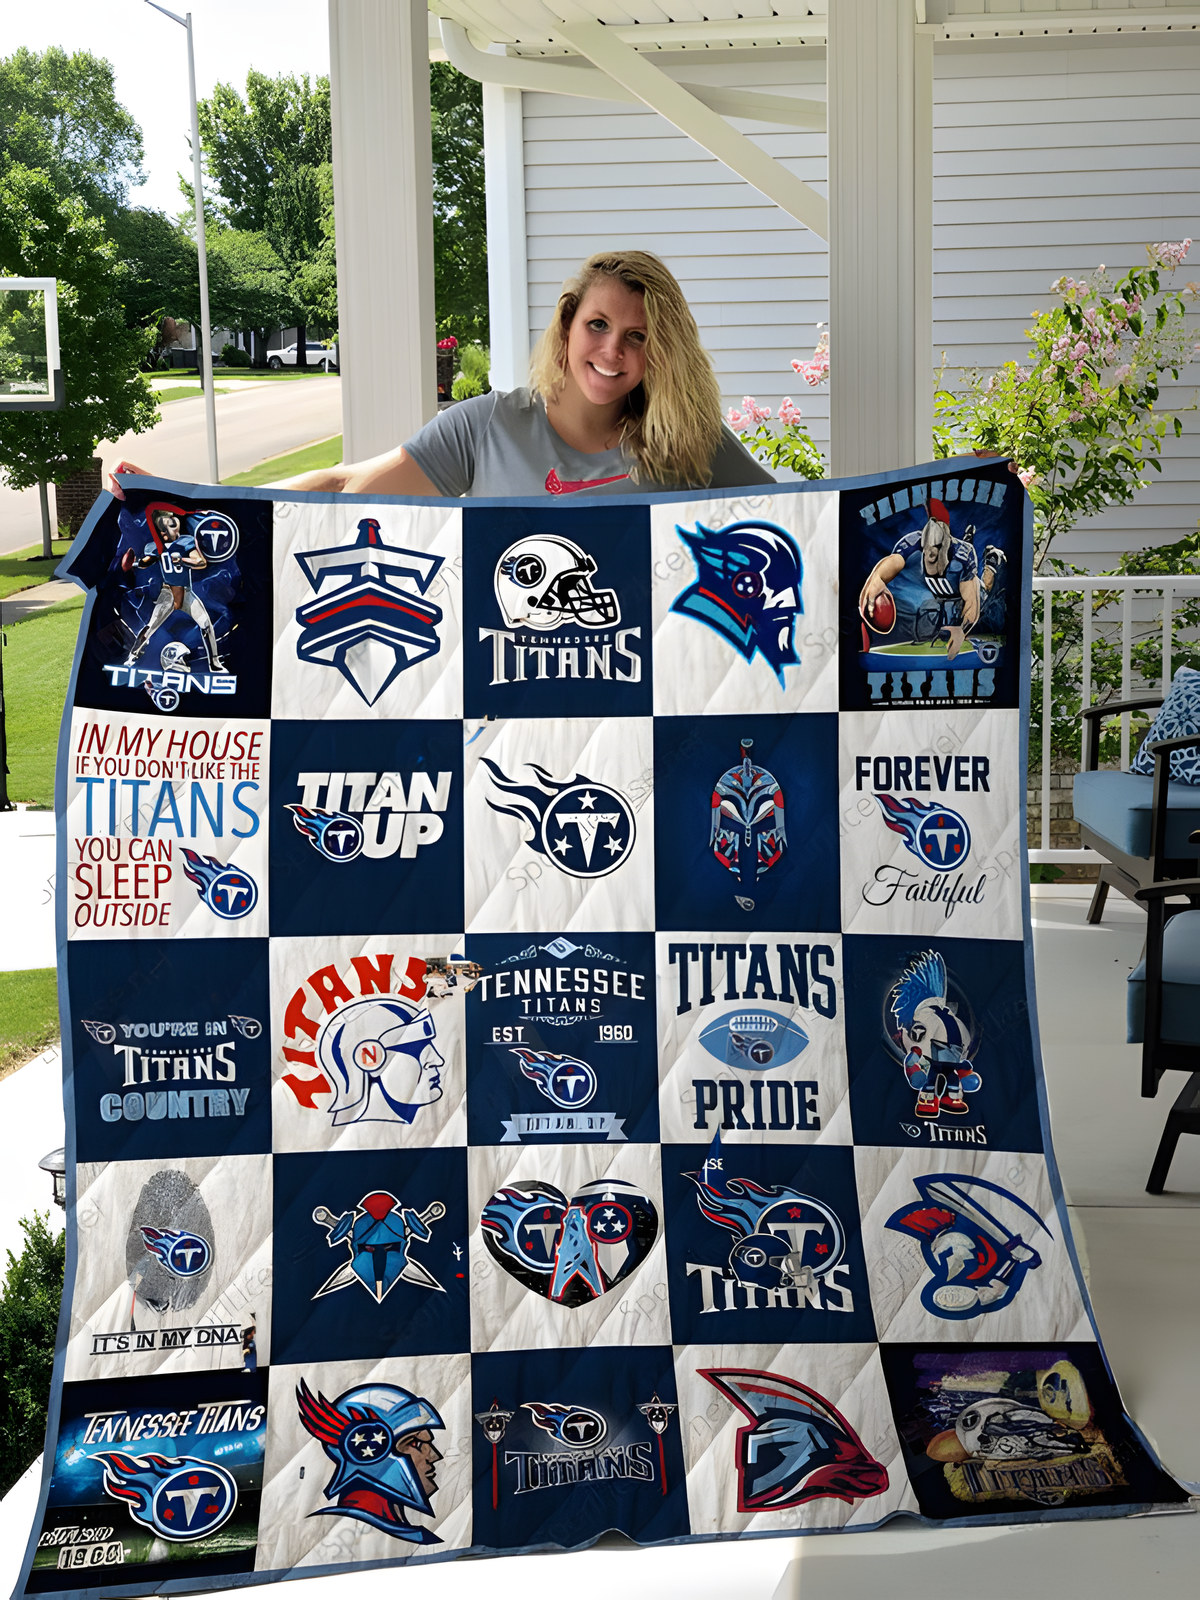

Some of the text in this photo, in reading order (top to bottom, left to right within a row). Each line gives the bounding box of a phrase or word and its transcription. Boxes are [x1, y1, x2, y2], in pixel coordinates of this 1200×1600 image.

[478, 626, 642, 686] TITANS
[102, 665, 238, 695] TITANS
[77, 722, 264, 761] IN MY HOUSE
[76, 755, 260, 780] IF YOU DON'T LIKE THE
[855, 755, 991, 792] FOREVER
[75, 777, 260, 838] TITANS
[297, 771, 452, 813] TITAN
[75, 837, 172, 862] YOU CAN
[363, 811, 444, 859] UP
[75, 863, 172, 900] SLEEP
[862, 864, 987, 919] Faithful
[75, 902, 171, 928] OUTSIDE
[478, 967, 646, 1001] TENNESSEE
[668, 943, 837, 1019] TITANS
[521, 997, 601, 1014] TITANS
[280, 953, 428, 1110] TITANS
[492, 1026, 525, 1042] EST
[599, 1025, 633, 1041] 1960
[114, 1041, 236, 1087] TITANS
[100, 1088, 251, 1122] COUNTRY
[692, 1079, 821, 1131] PRIDE
[924, 1121, 988, 1145] TITANS
[686, 1262, 855, 1313] TITANS
[136, 1332, 155, 1349] IN
[161, 1330, 192, 1347] MY
[196, 1327, 240, 1345] DNA
[83, 1410, 198, 1445] TENNESSEE
[504, 1442, 655, 1495] TITANS
